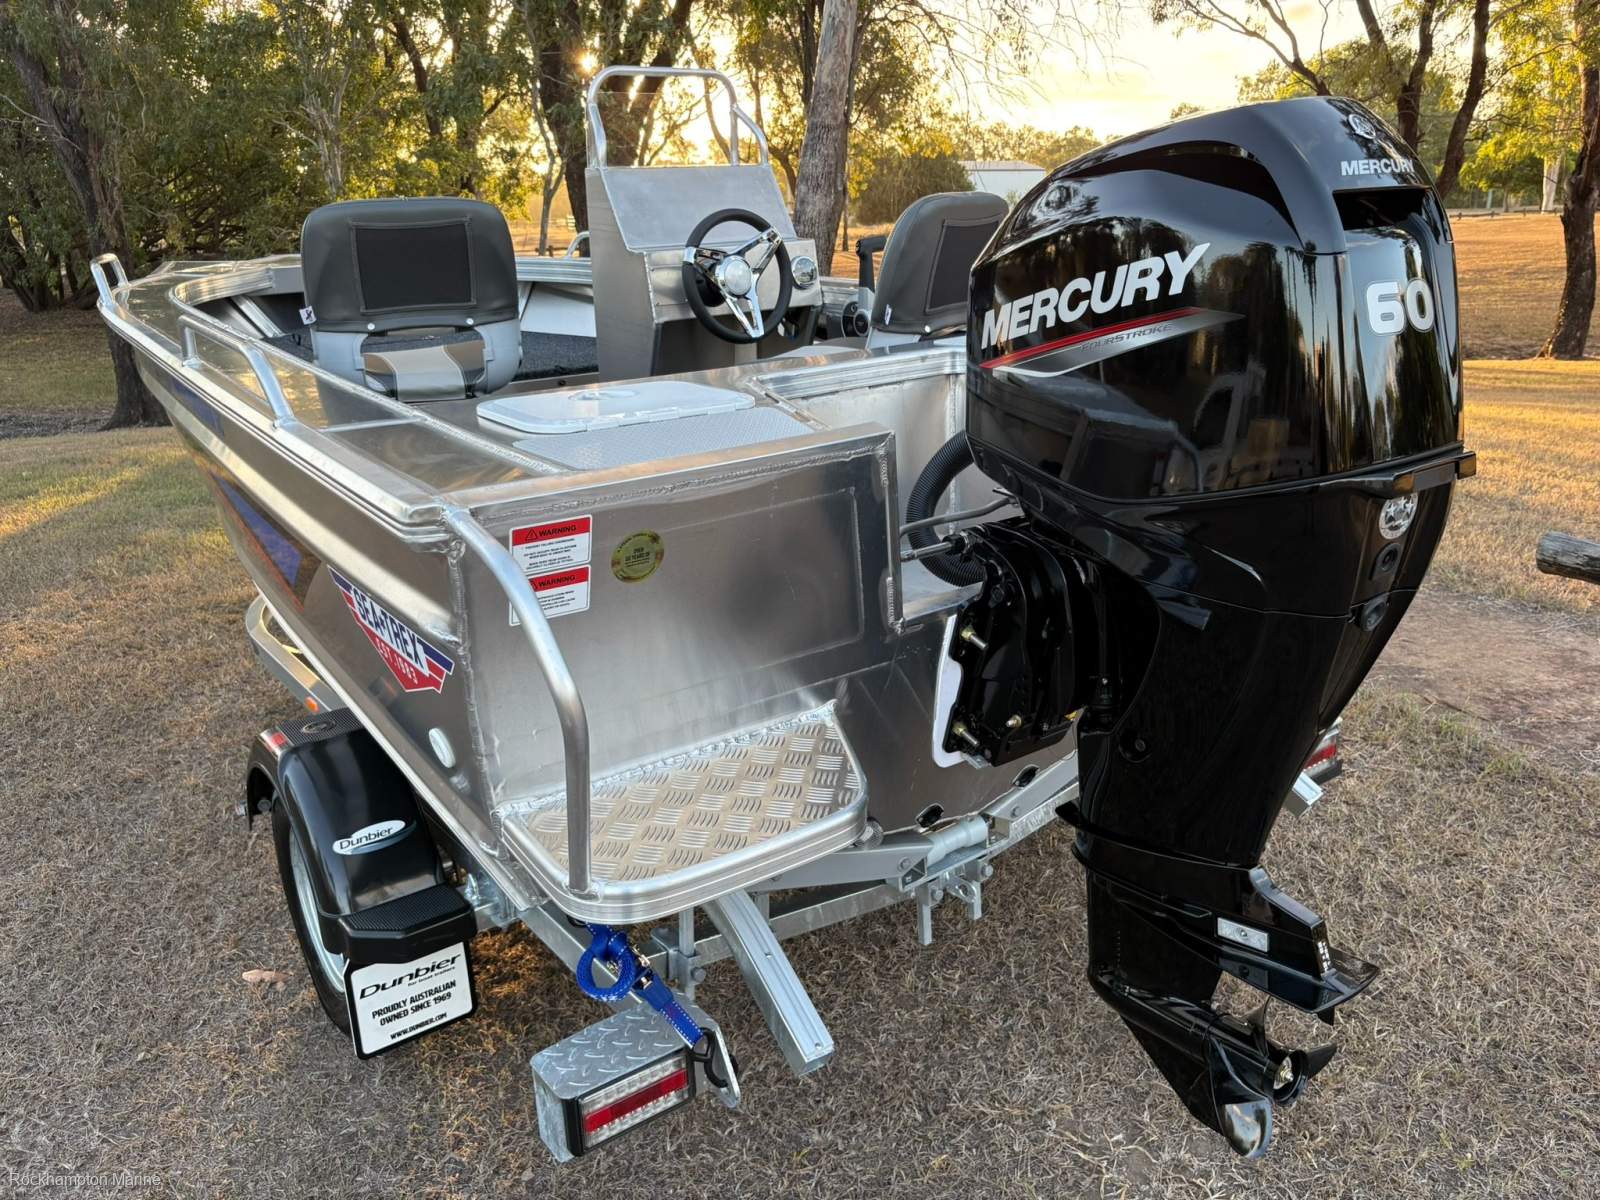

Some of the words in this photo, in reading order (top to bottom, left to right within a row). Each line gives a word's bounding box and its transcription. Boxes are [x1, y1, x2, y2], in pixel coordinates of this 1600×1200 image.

[1341, 158, 1416, 177] MERCURY
[981, 242, 1211, 349] MERCURY
[1366, 278, 1435, 336] 60
[539, 524, 577, 537] WARNING
[538, 574, 577, 587] WARNING
[340, 827, 393, 850] Dunbier
[360, 953, 461, 999] Dunbier
[372, 998, 407, 1019] PROUDLY
[409, 980, 456, 1004] AUSTRALIAN
[380, 1010, 409, 1026] OWNED
[411, 1000, 432, 1014] SINCE
[434, 992, 452, 1004] 1969
